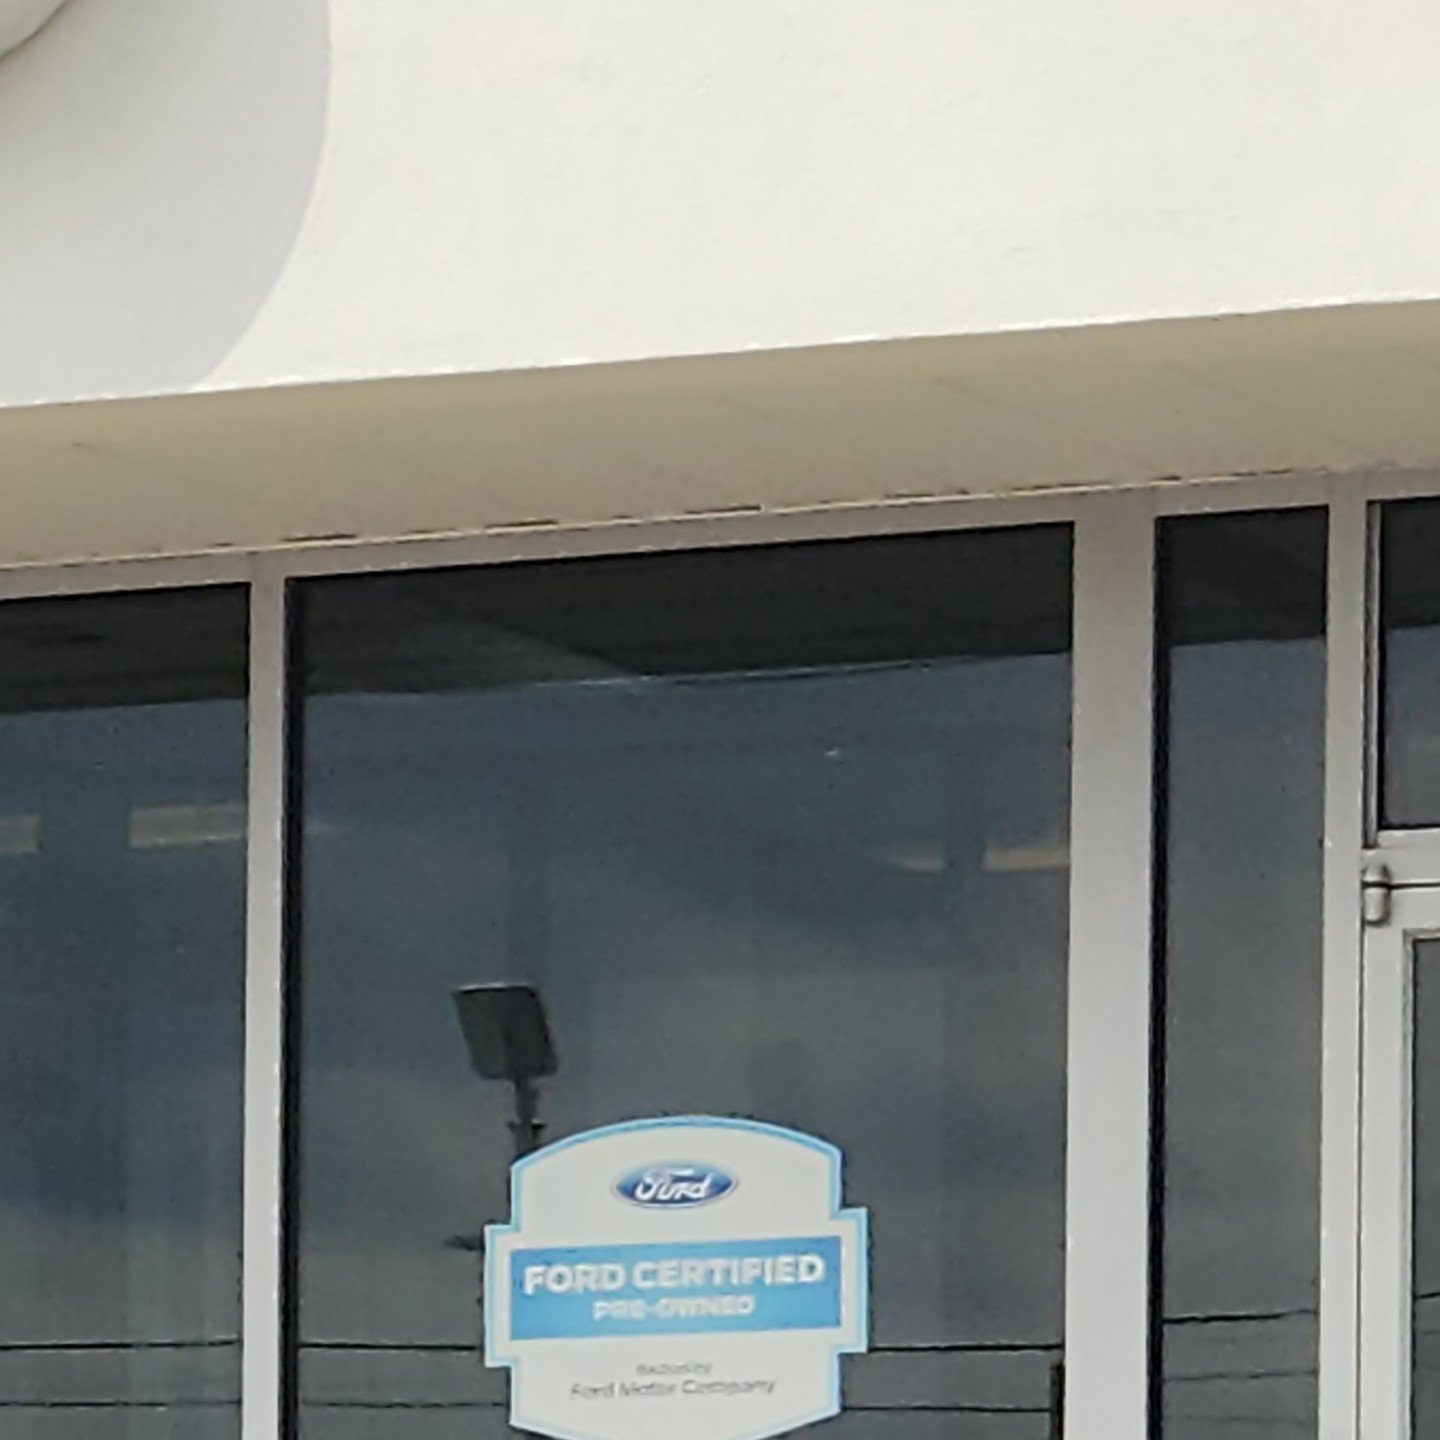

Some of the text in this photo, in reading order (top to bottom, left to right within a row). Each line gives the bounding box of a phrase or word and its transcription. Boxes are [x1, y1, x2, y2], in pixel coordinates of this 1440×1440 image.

[523, 1254, 825, 1294] FORD CERTIFIED
[593, 1296, 755, 1320] PRE-OWNED
